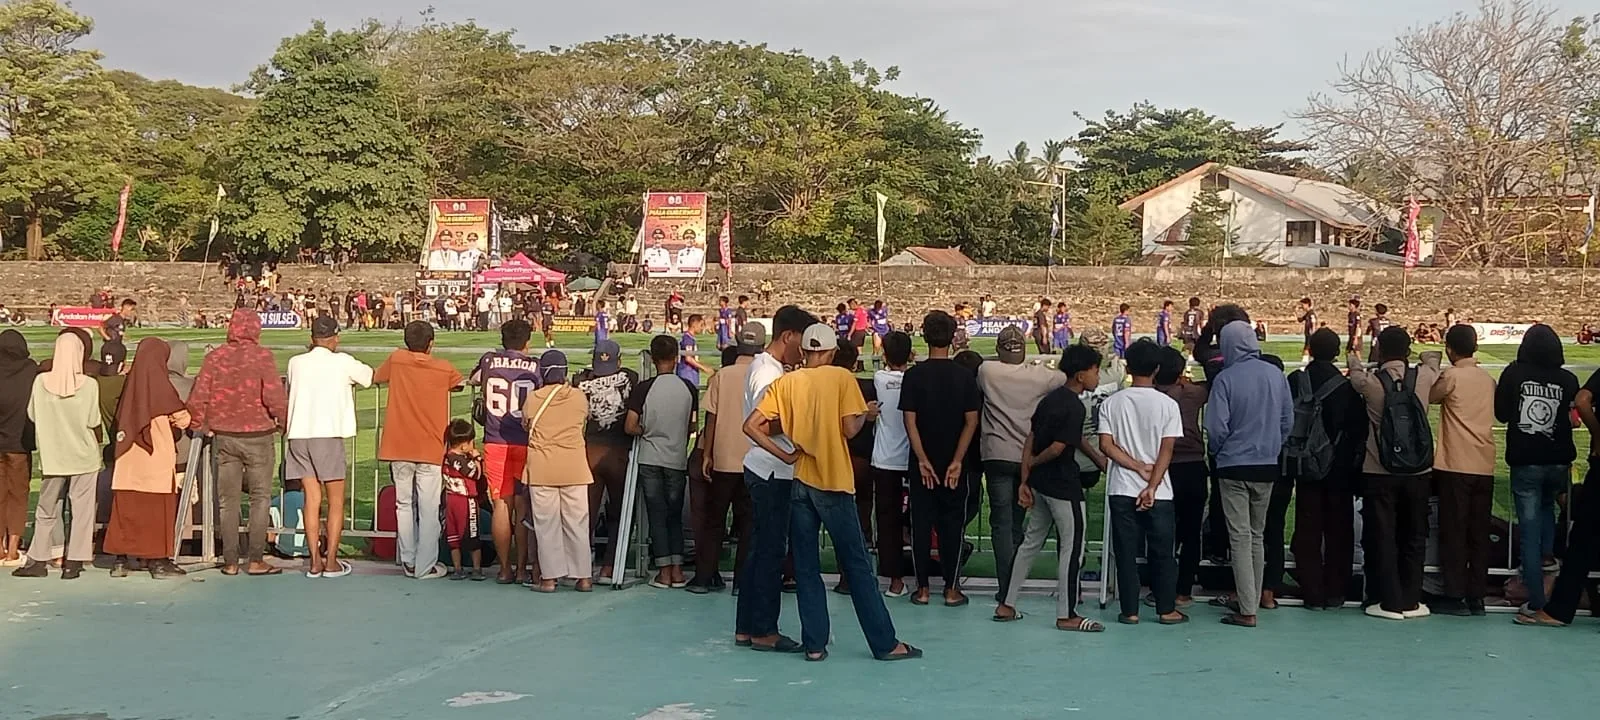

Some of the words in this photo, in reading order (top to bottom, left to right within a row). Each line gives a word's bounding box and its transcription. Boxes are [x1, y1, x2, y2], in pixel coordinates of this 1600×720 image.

[268, 312, 295, 325] SULSEL
[485, 377, 536, 418] 60
[1522, 384, 1560, 400] NIRVANA
